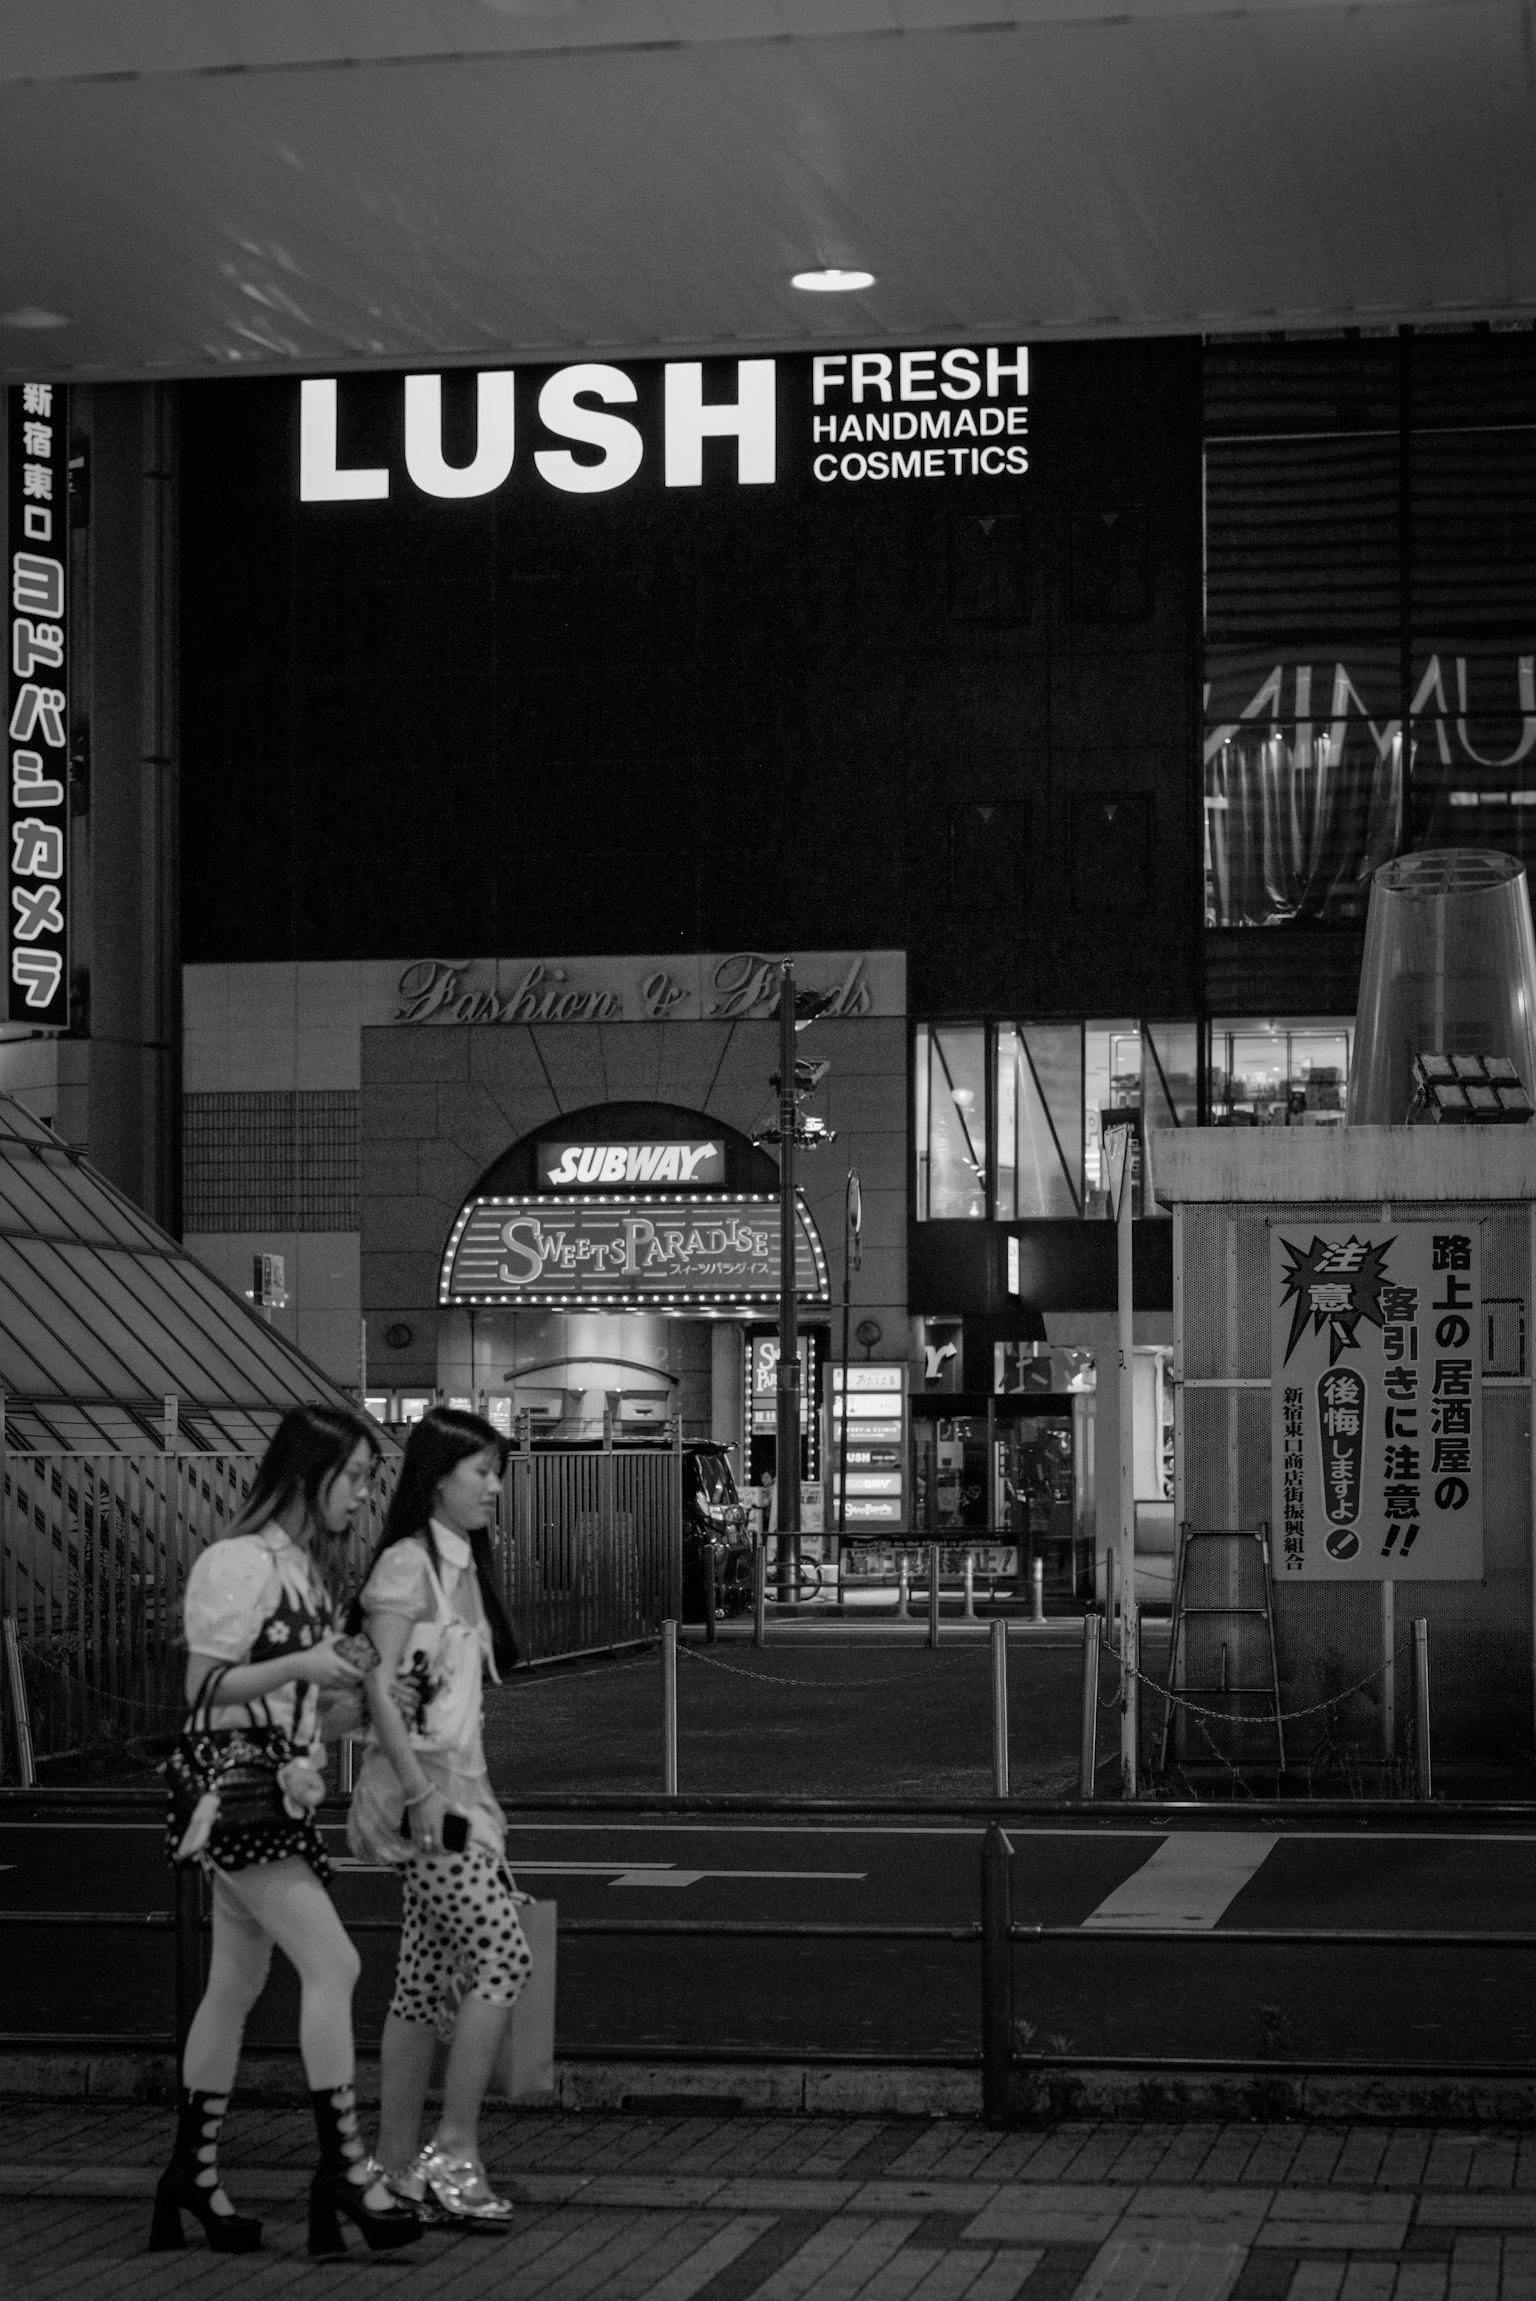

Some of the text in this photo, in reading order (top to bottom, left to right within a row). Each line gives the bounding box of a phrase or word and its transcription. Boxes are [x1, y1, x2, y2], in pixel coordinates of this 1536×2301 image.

[813, 346, 1029, 405] FRESH
[300, 359, 777, 502] LUSH
[813, 406, 1029, 443] HANDMADE
[813, 446, 1029, 482] COSMETICS
[8, 551, 66, 1009] ヨドバシカメラ
[395, 958, 619, 1022] Fashion
[703, 951, 871, 1017] Fds
[547, 1142, 718, 1185] SUBWAY
[500, 1217, 770, 1284] SWEETS PARADISE
[1430, 1234, 1474, 1511] 路上の居酒屋の
[846, 1452, 871, 1463] USH
